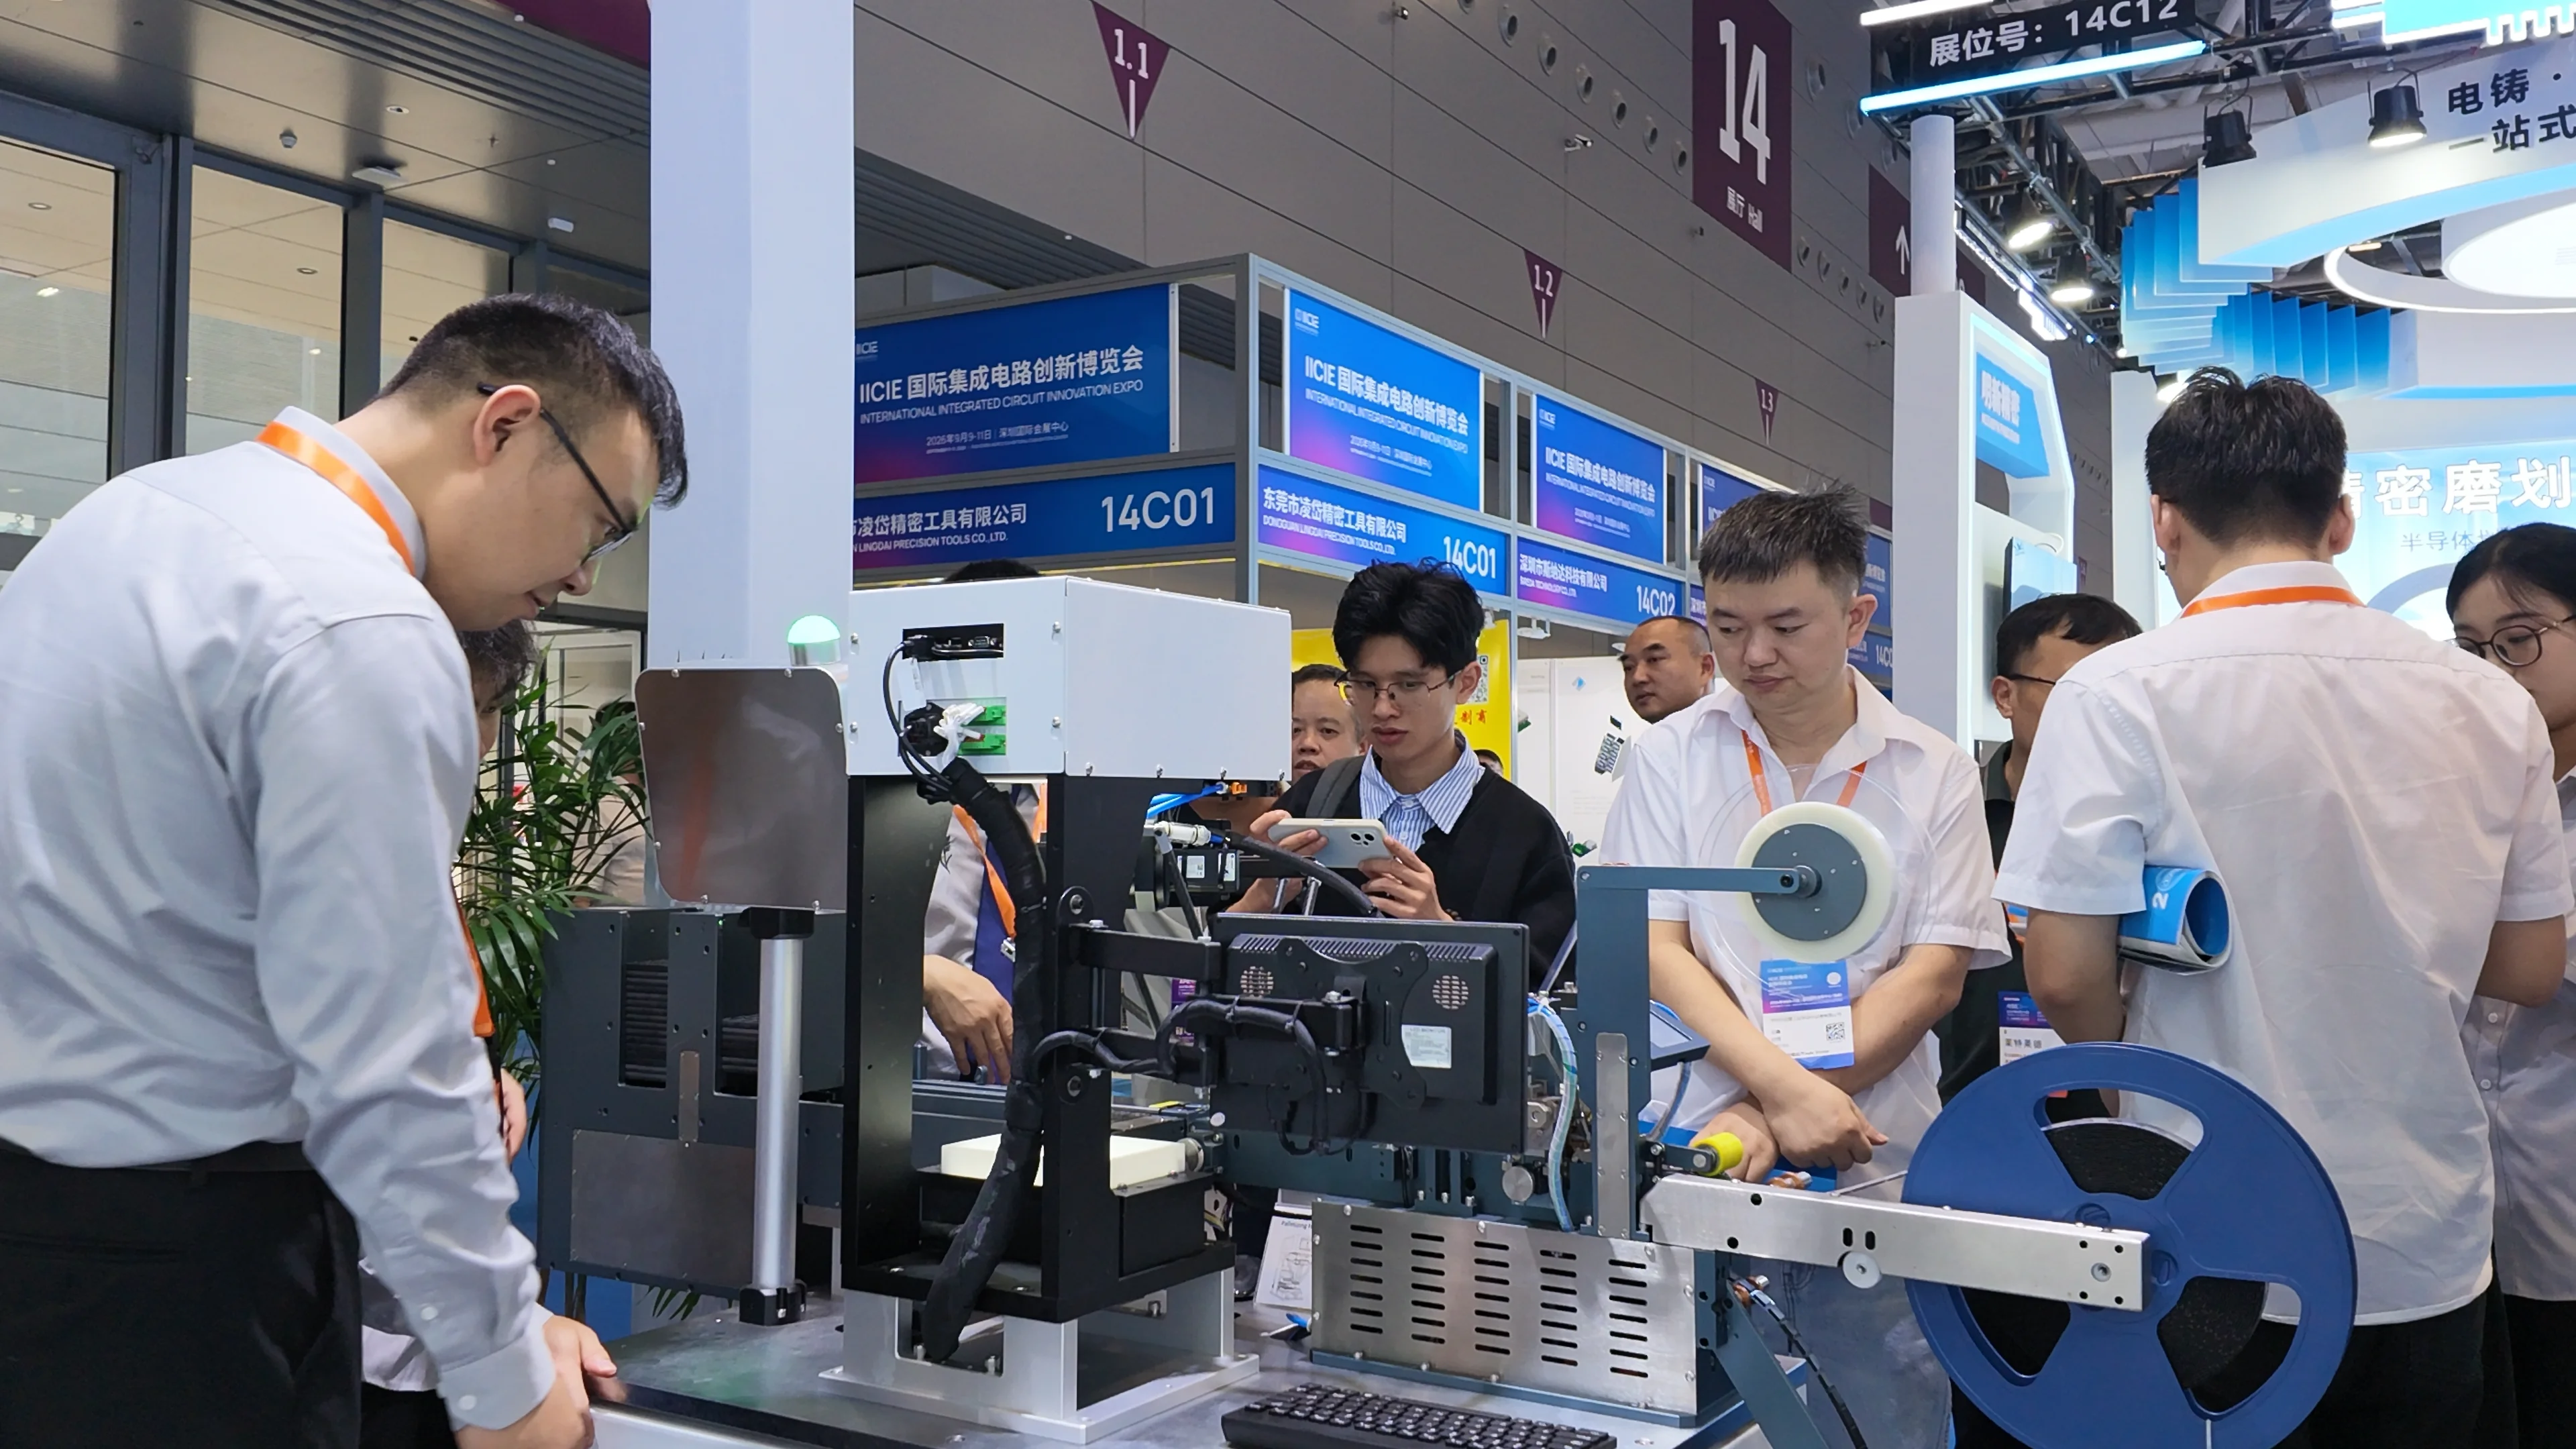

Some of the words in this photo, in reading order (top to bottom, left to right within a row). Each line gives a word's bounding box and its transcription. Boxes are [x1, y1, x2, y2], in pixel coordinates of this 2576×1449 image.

[2065, 0, 2178, 36] 14C12
[1114, 28, 1148, 80] 1.1
[1719, 19, 1770, 185] 14
[2449, 103, 2576, 154] 一站式
[1534, 264, 1553, 297] 1.2
[860, 378, 903, 403] IICIE
[908, 343, 1144, 400] 国际集成电路创新博览会
[1305, 355, 1336, 387] IICIE
[1338, 366, 1468, 436] 国际集成电路创新博览会
[860, 406, 937, 424] INTERNATIONAL
[938, 397, 1001, 415] INTEGRATED
[1002, 391, 1045, 408] CIRCUIT
[1046, 383, 1112, 402] INNOVATION
[1114, 379, 1144, 394] EXPO
[853, 503, 1027, 537] 凌岱精密工具有限公司
[1102, 487, 1214, 532] 14C01
[1263, 486, 1407, 543] 东莞市凌岱精密工具有限公司
[1443, 536, 1496, 579] 14C01
[859, 541, 892, 553] LINGDAI
[894, 536, 939, 550] PRECISION
[941, 533, 970, 545] TOOLS
[1637, 584, 1676, 616] 14C02
